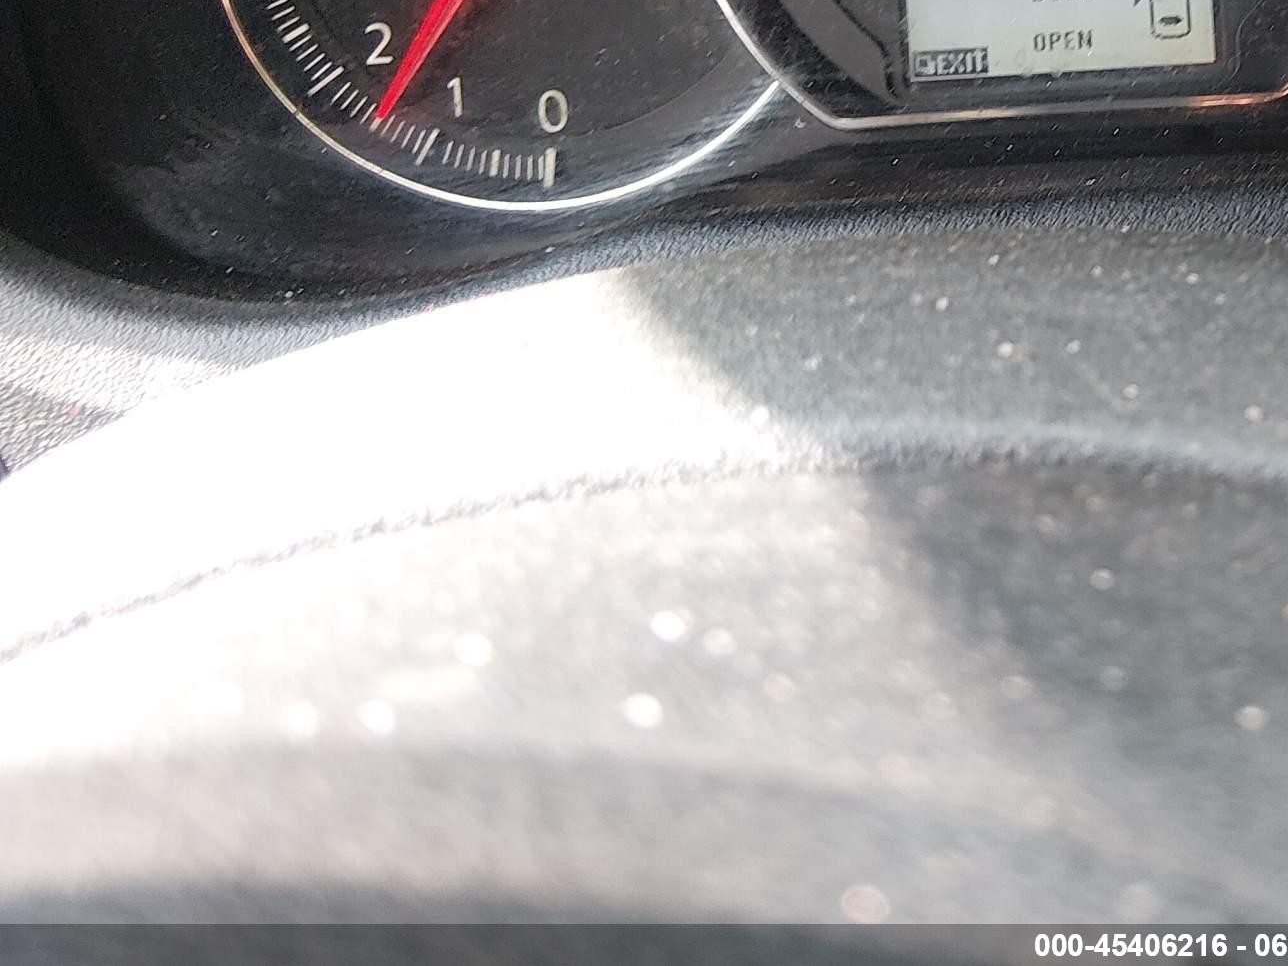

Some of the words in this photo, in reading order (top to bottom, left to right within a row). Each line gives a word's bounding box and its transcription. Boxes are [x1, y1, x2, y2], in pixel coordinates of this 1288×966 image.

[364, 24, 395, 66] 2
[1033, 29, 1093, 52] OPEN
[936, 48, 988, 74] EXIT
[446, 77, 464, 117] 1
[537, 89, 568, 132] 0
